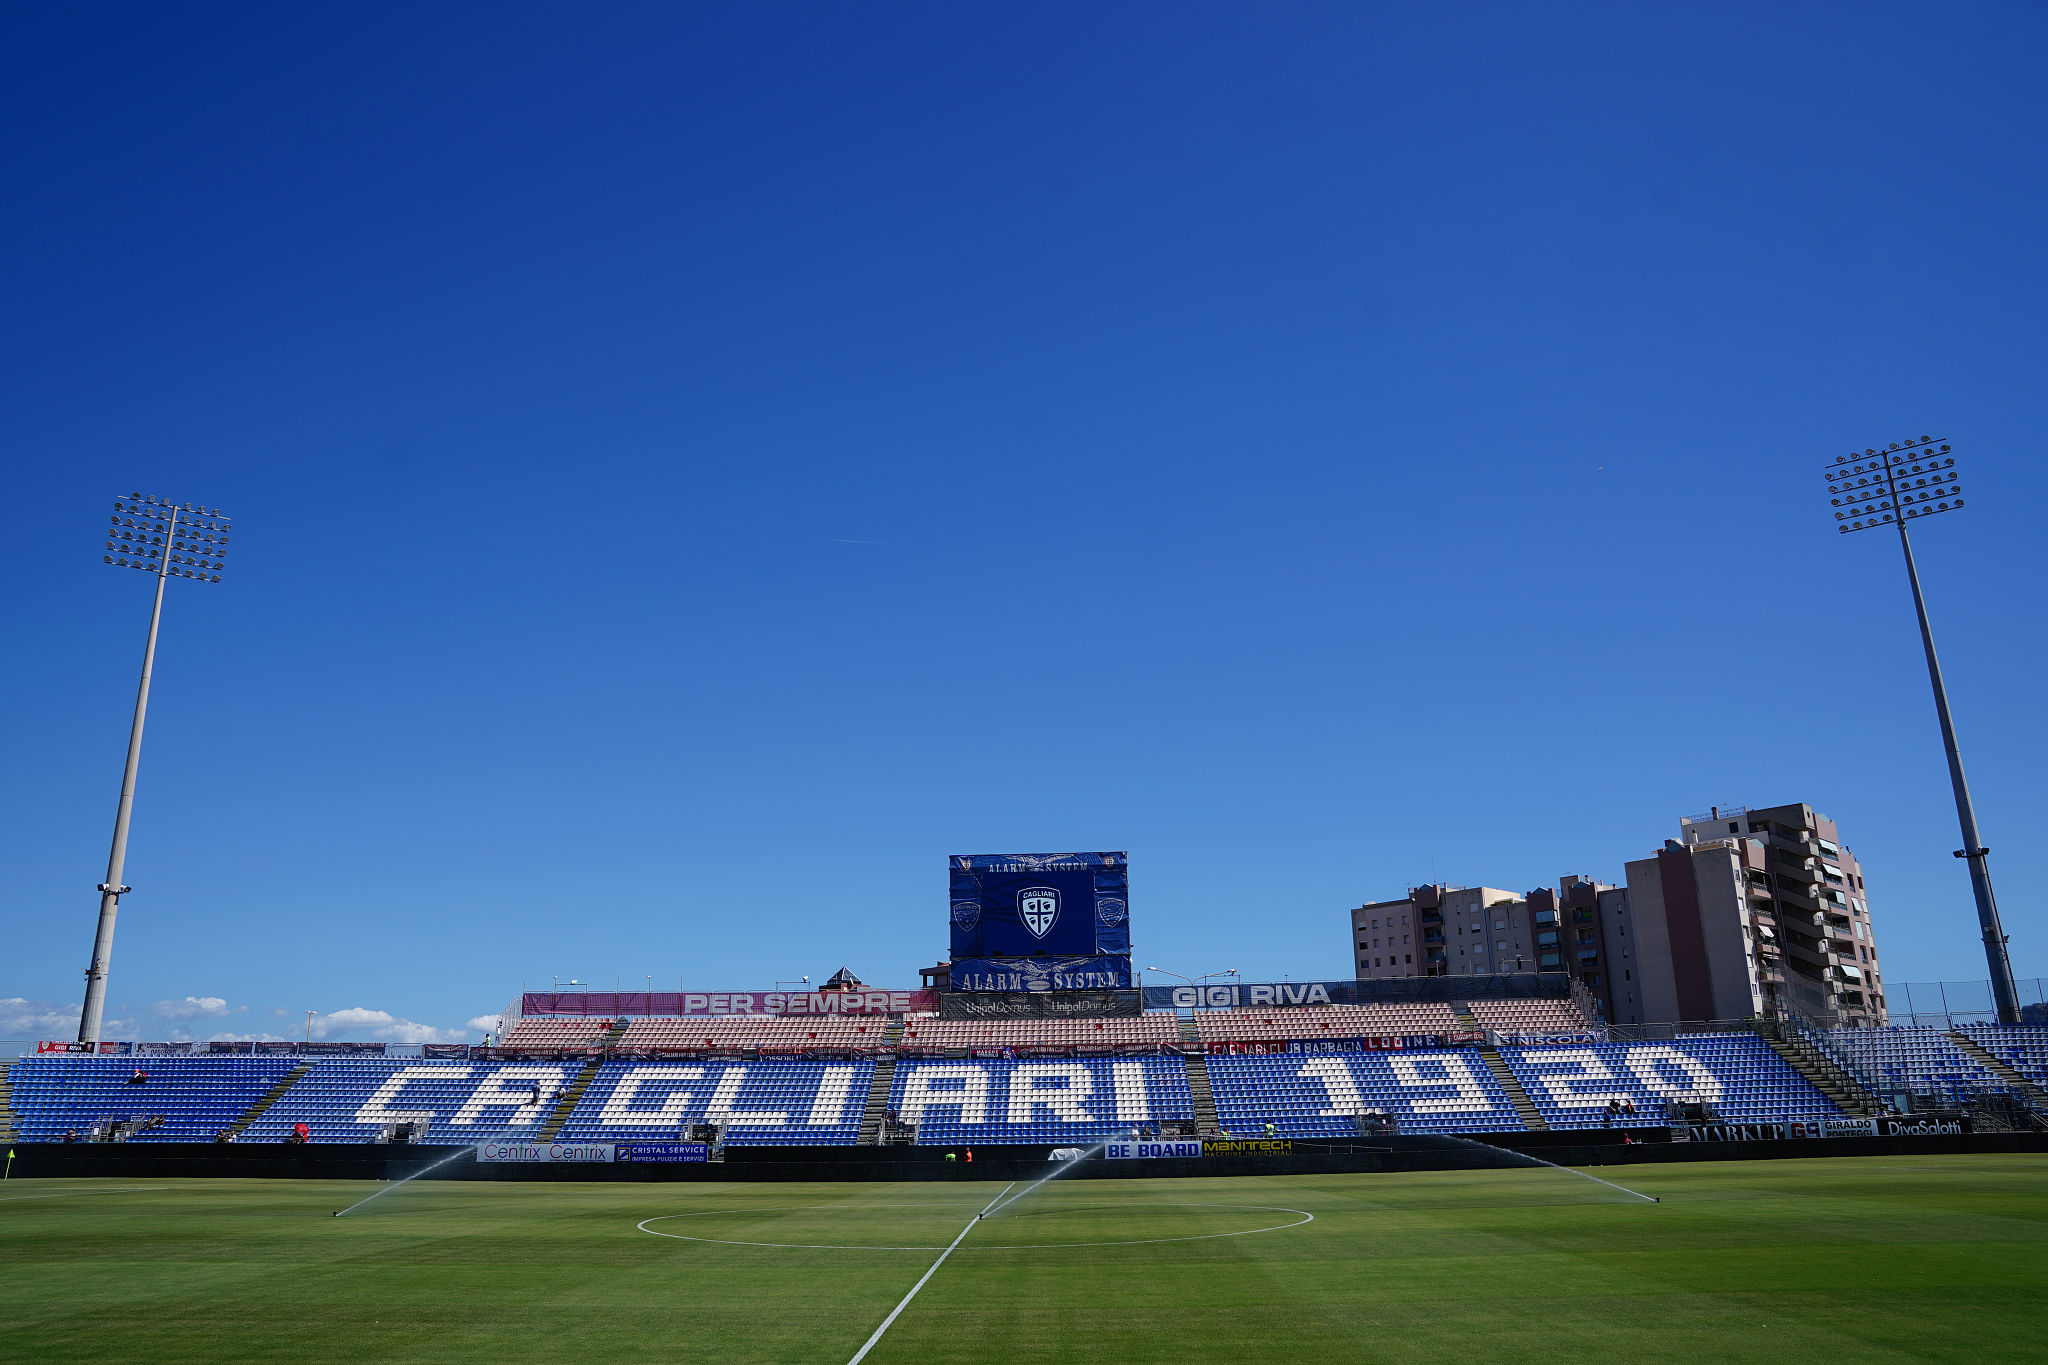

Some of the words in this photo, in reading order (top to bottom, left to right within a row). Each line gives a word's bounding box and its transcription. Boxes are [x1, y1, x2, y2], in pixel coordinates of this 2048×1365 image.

[988, 862, 1026, 873] ALARM
[1045, 862, 1088, 872] SYSTEM
[1023, 890, 1056, 899] CAGLIARI
[962, 973, 1023, 990] ALARM
[1054, 971, 1121, 990] SYSTEM
[1172, 985, 1240, 1007] GIGI
[1250, 983, 1332, 1006] RIVA
[684, 994, 754, 1014] PER
[763, 993, 912, 1014] SEMPRE
[1500, 1036, 1594, 1046] SINISCOLA
[1297, 1046, 1723, 1116] 1920
[1825, 1120, 1872, 1130] GIRALDO
[1888, 1118, 1962, 1136] DivaSalotti
[1690, 1124, 1784, 1142] MARKUP
[484, 1144, 541, 1159] Centrix
[550, 1144, 606, 1159] Centrix
[1108, 1143, 1131, 1158] BE
[1138, 1143, 1199, 1157] BOARD
